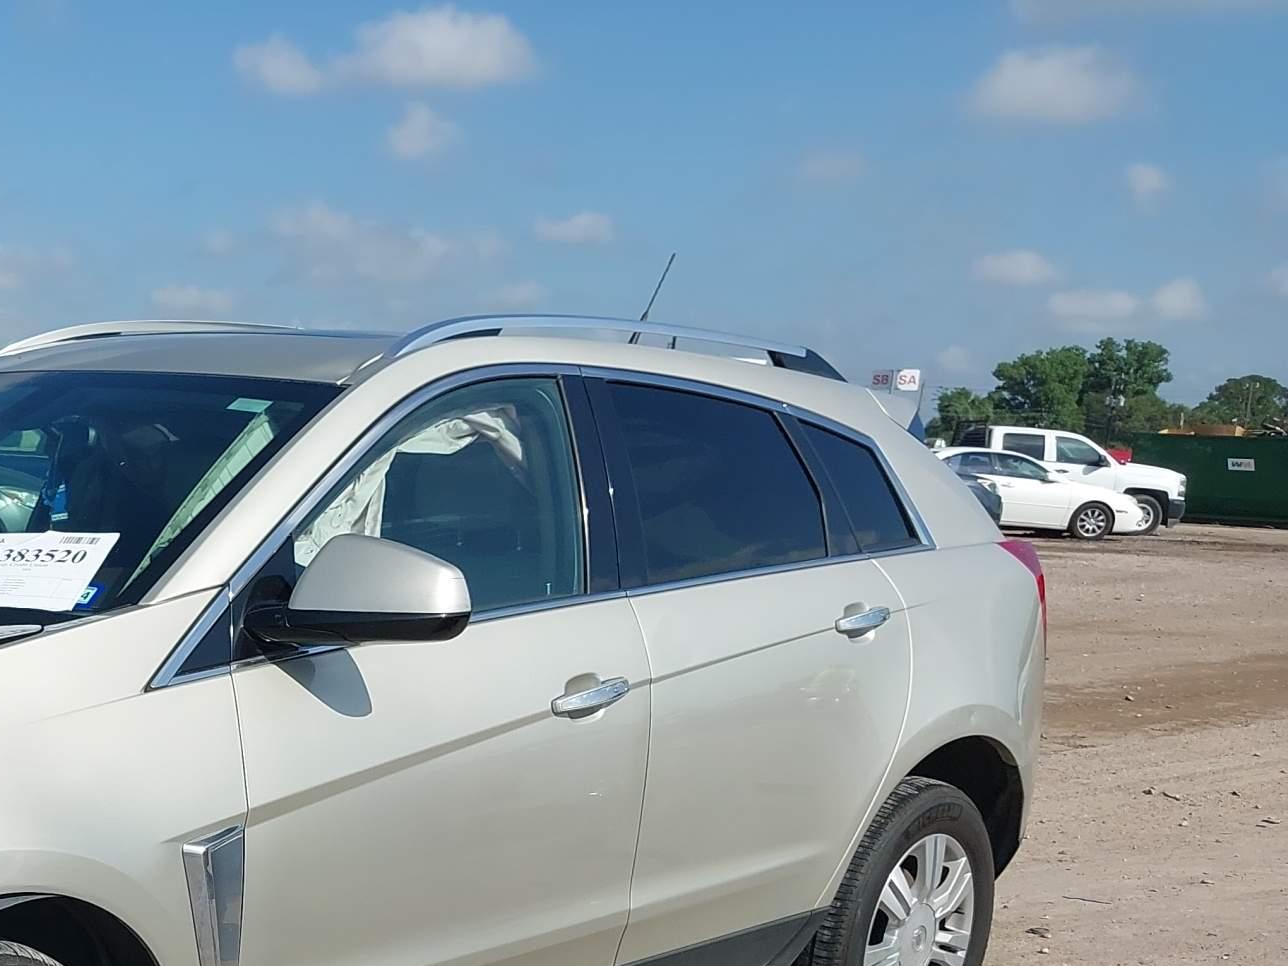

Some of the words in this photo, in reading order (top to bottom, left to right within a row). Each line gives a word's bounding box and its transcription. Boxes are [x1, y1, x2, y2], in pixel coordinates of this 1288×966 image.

[872, 374, 889, 385] SB
[898, 374, 917, 386] SA
[81, 591, 91, 600] 4
